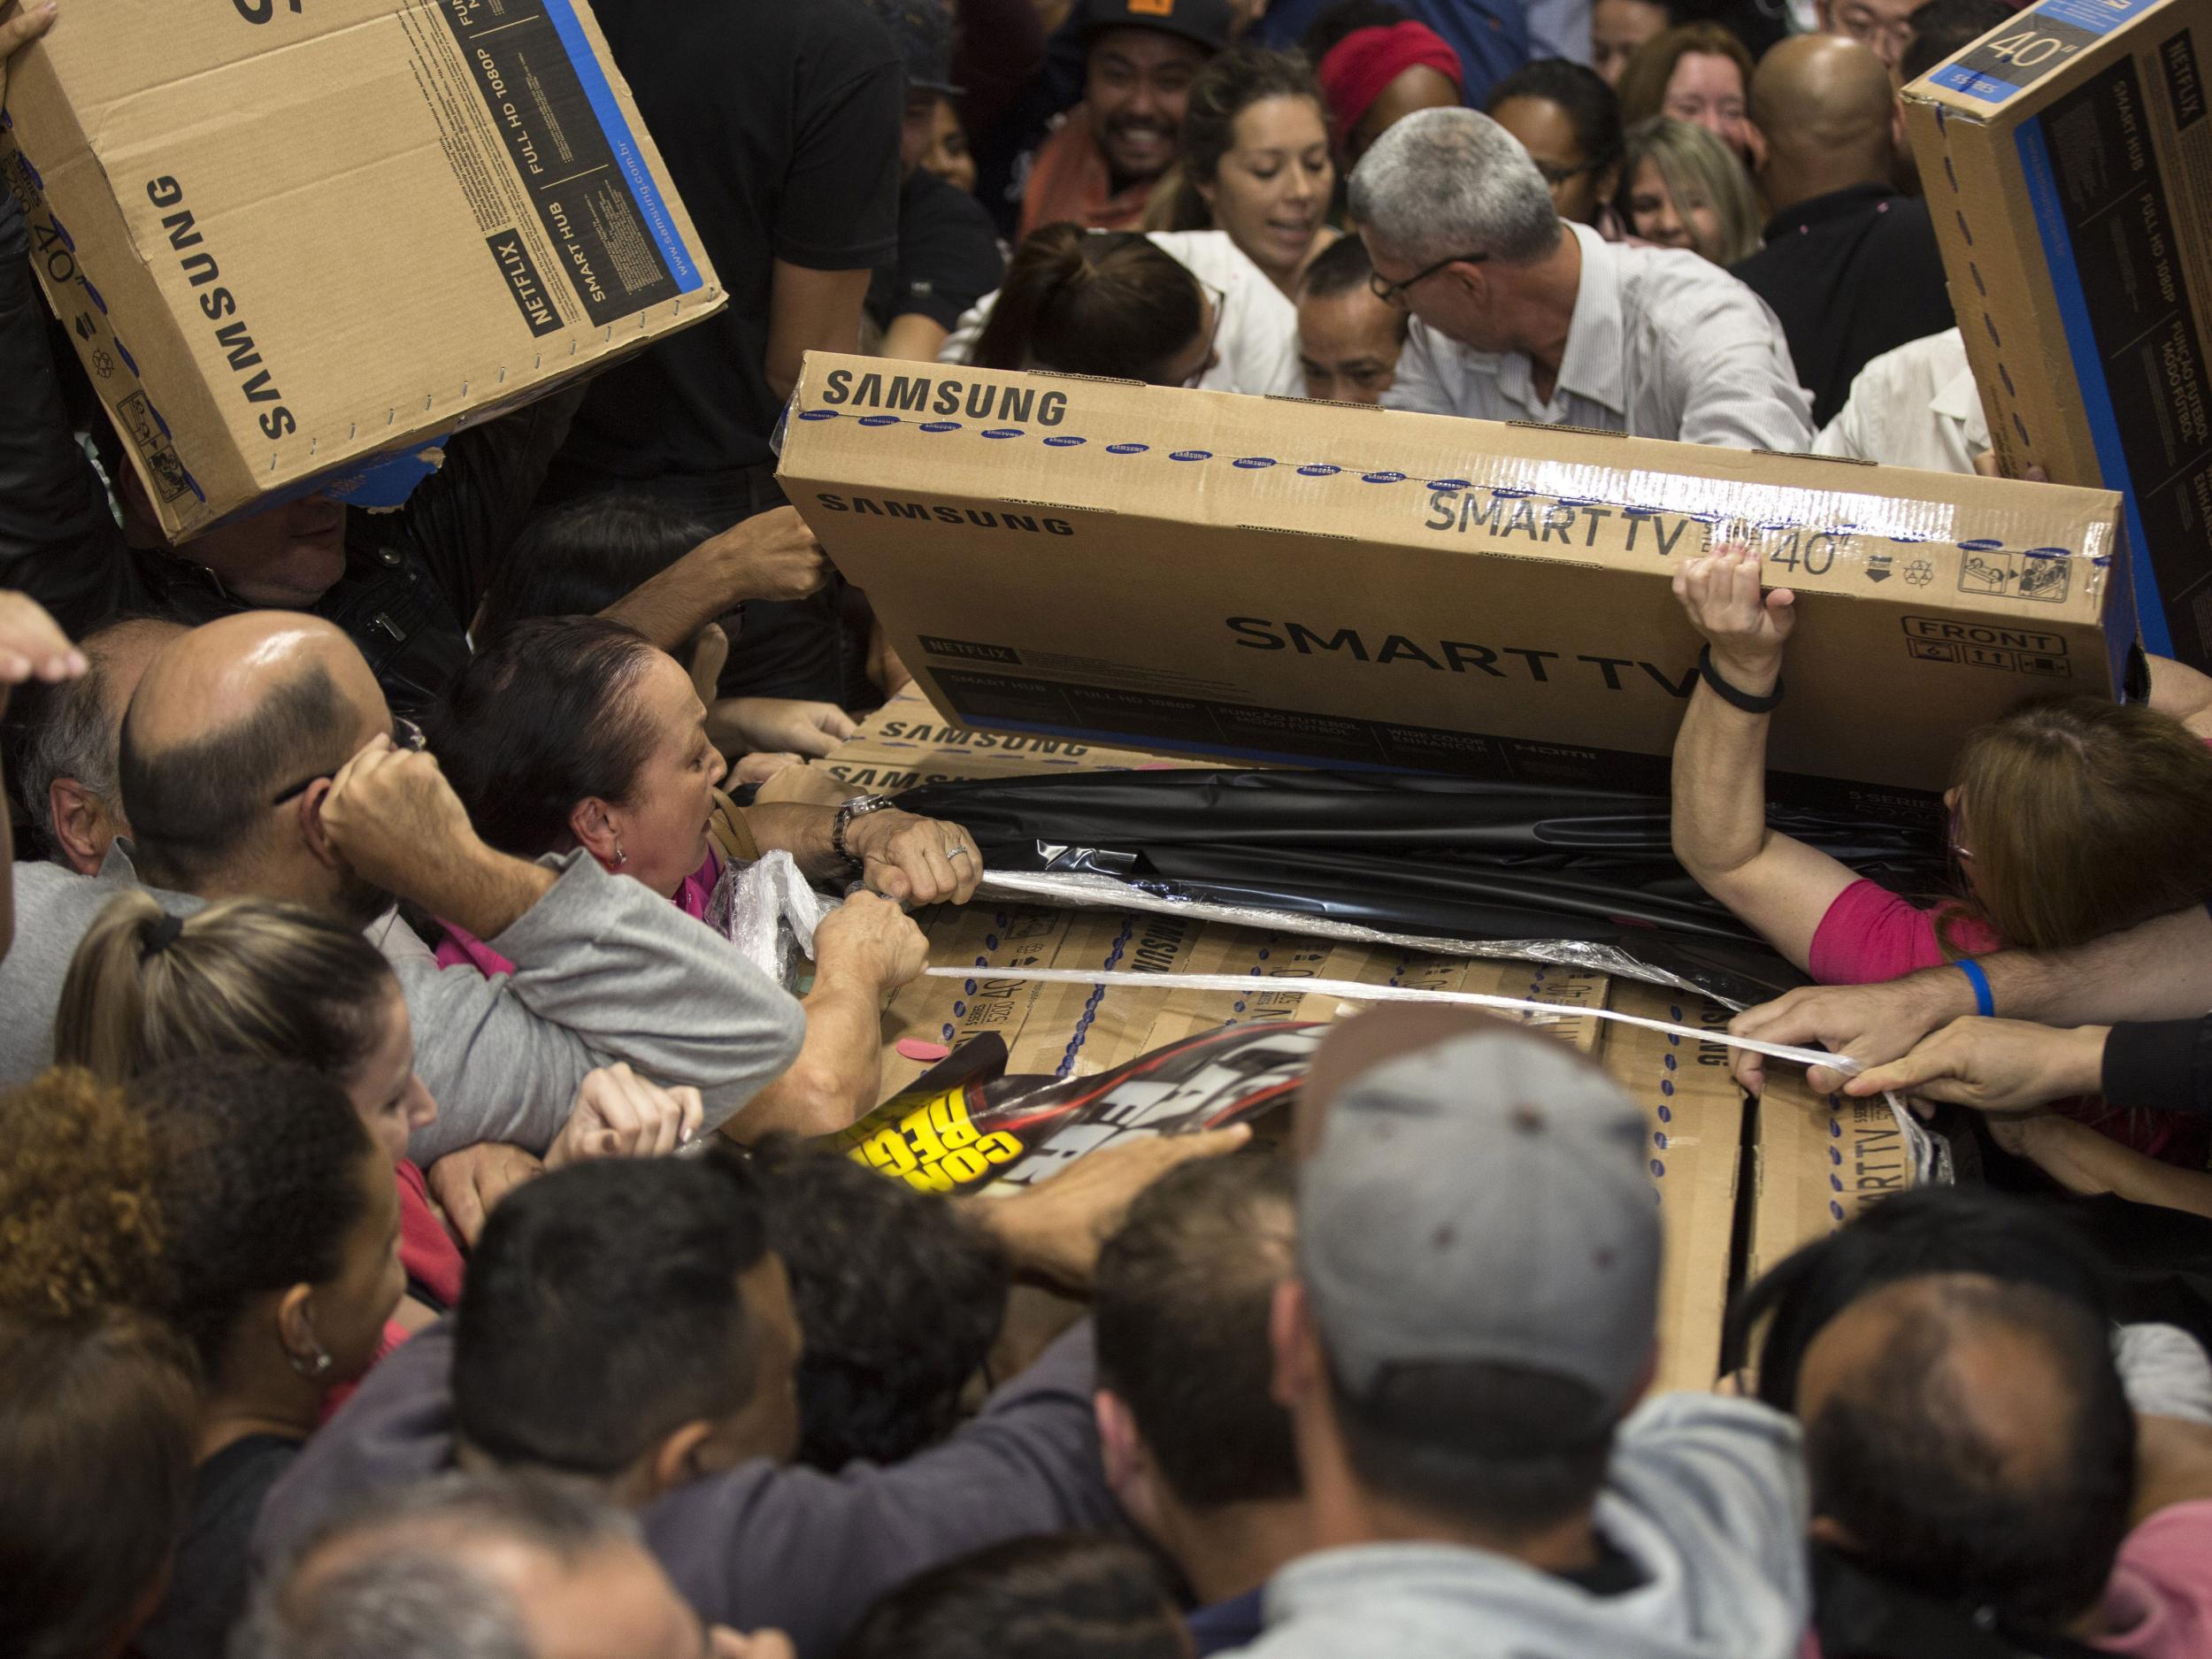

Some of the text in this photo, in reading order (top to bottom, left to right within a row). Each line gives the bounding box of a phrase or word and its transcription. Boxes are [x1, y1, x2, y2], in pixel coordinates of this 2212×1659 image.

[1987, 31, 2078, 67] 40"
[475, 47, 508, 98] 1080P
[2169, 40, 2200, 116] NETFLIX
[500, 101, 522, 127] HD
[2114, 79, 2146, 172] SMART HUB
[513, 130, 543, 174] FULL
[616, 137, 688, 276] www.samsung.com.br
[2139, 191, 2158, 234] FULL
[548, 201, 606, 303] SMART HUB
[2148, 232, 2165, 258] HD
[496, 239, 552, 326] NETFLIX
[146, 174, 296, 440] SAMSUNG
[823, 370, 1067, 426] SAMSUNG
[817, 493, 1074, 535] SAMSUNG
[1425, 490, 1688, 556] SMART TV
[1770, 532, 1850, 575] 40"
[929, 640, 1010, 660] NETFLIX
[1226, 617, 1559, 682] SMART
[1578, 655, 1700, 698] TV
[1916, 622, 2053, 650] FRONT
[950, 674, 1047, 693] SMART HUB
[1073, 688, 1113, 702] FULL
